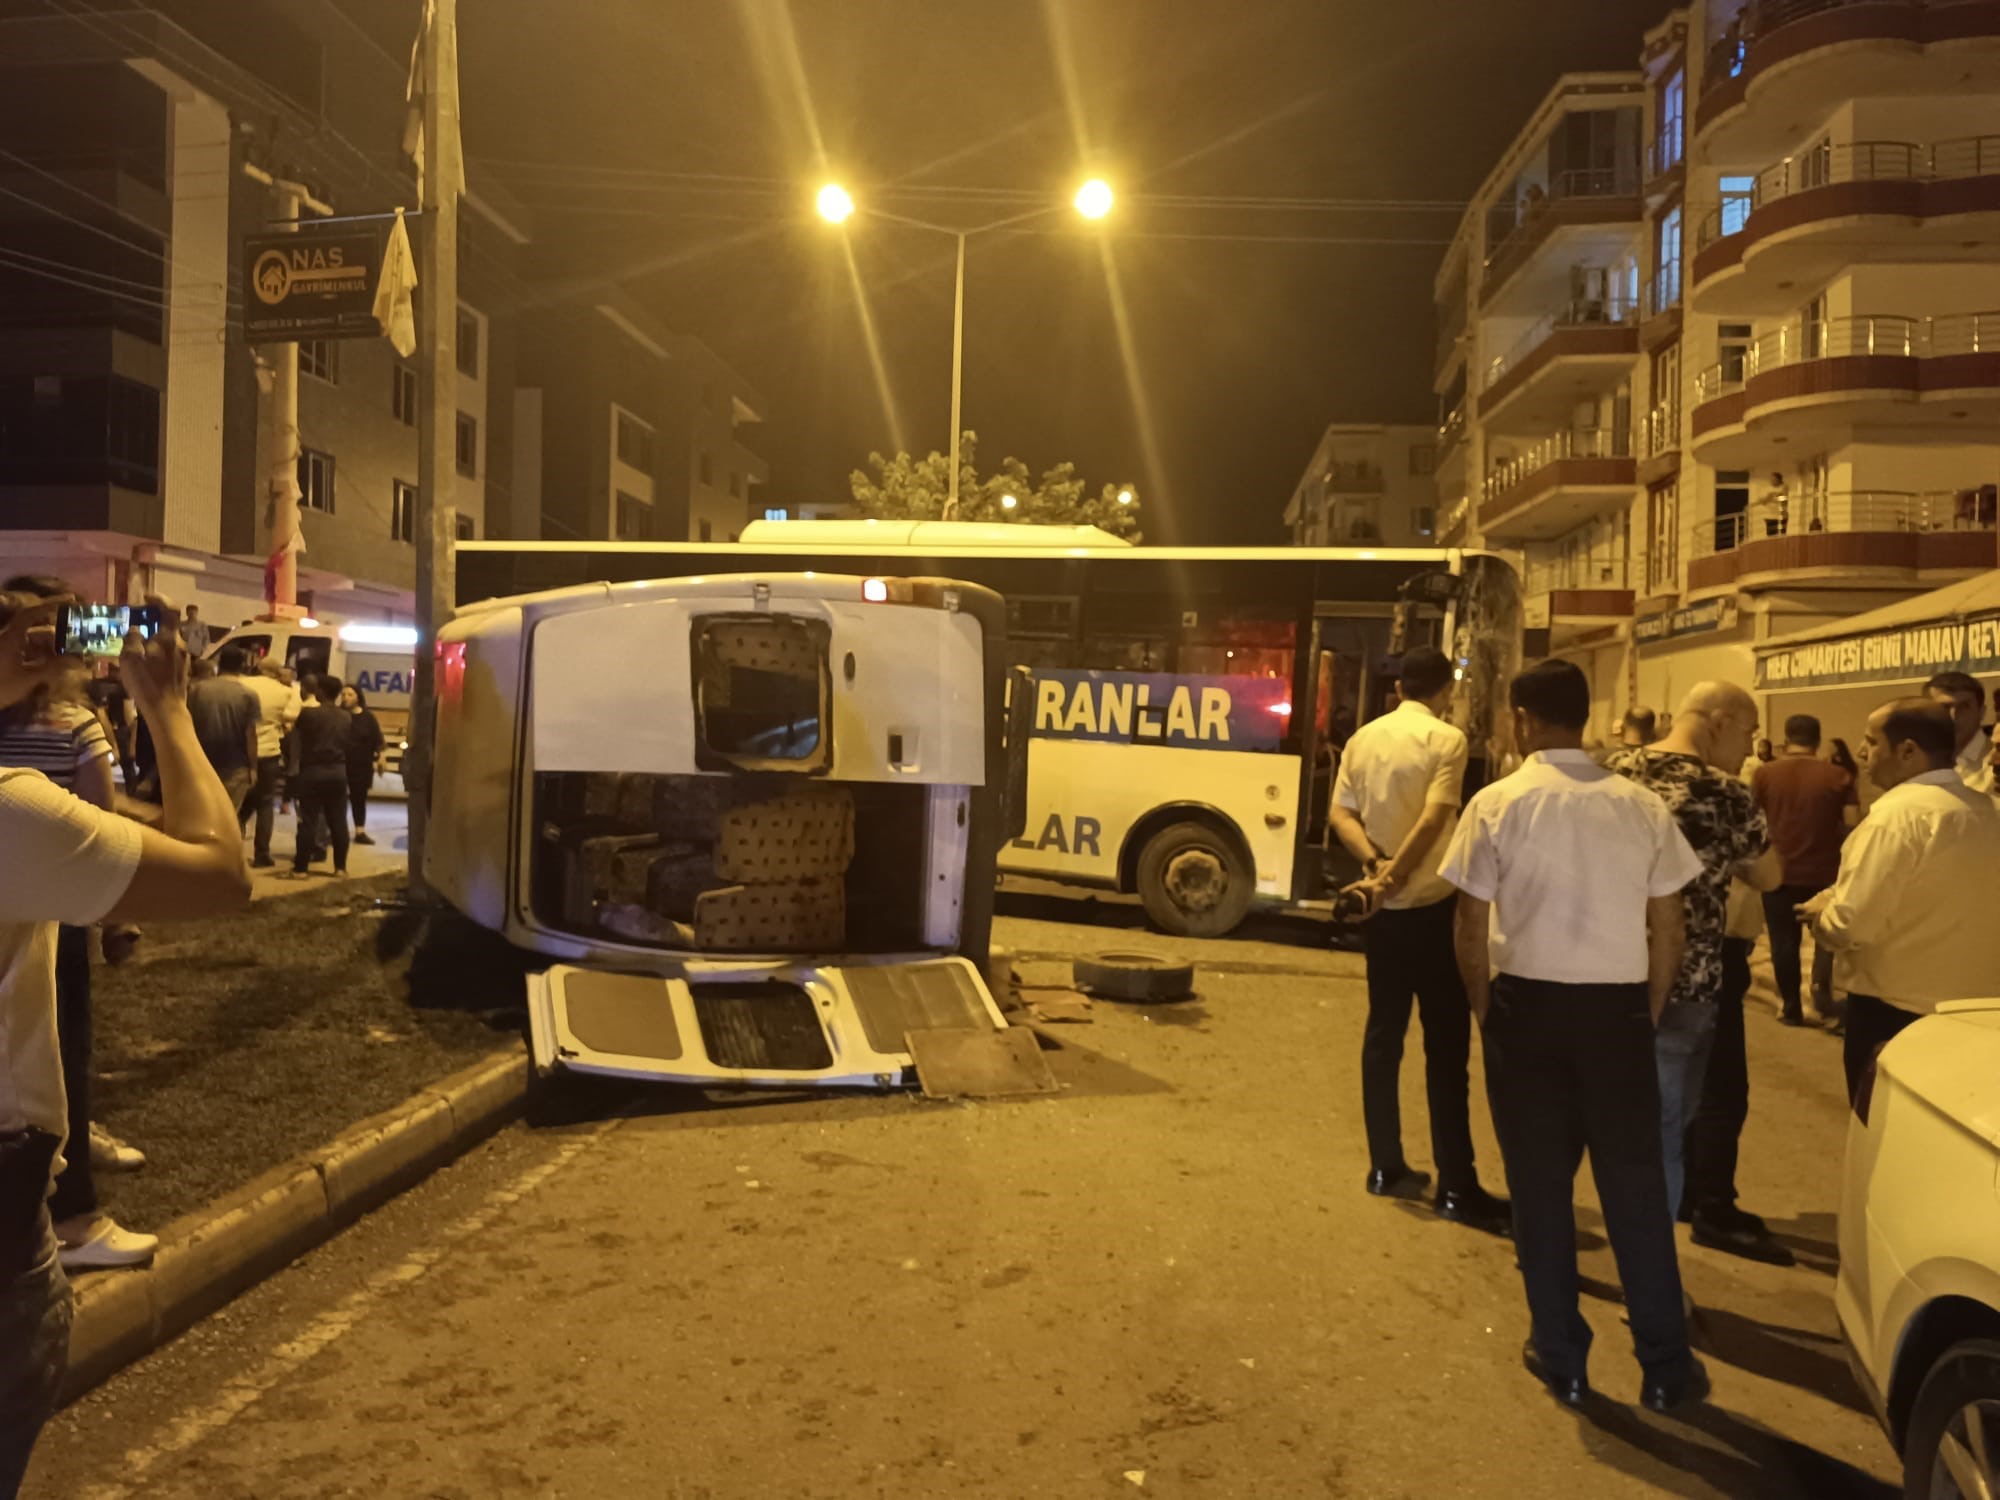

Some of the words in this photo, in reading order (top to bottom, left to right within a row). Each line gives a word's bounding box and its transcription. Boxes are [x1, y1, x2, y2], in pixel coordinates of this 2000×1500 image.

[293, 247, 343, 269] NAS
[1863, 632, 1902, 672] GÜNÜ
[1904, 625, 1965, 667] MANAV
[1003, 677, 1232, 742] RANLAR
